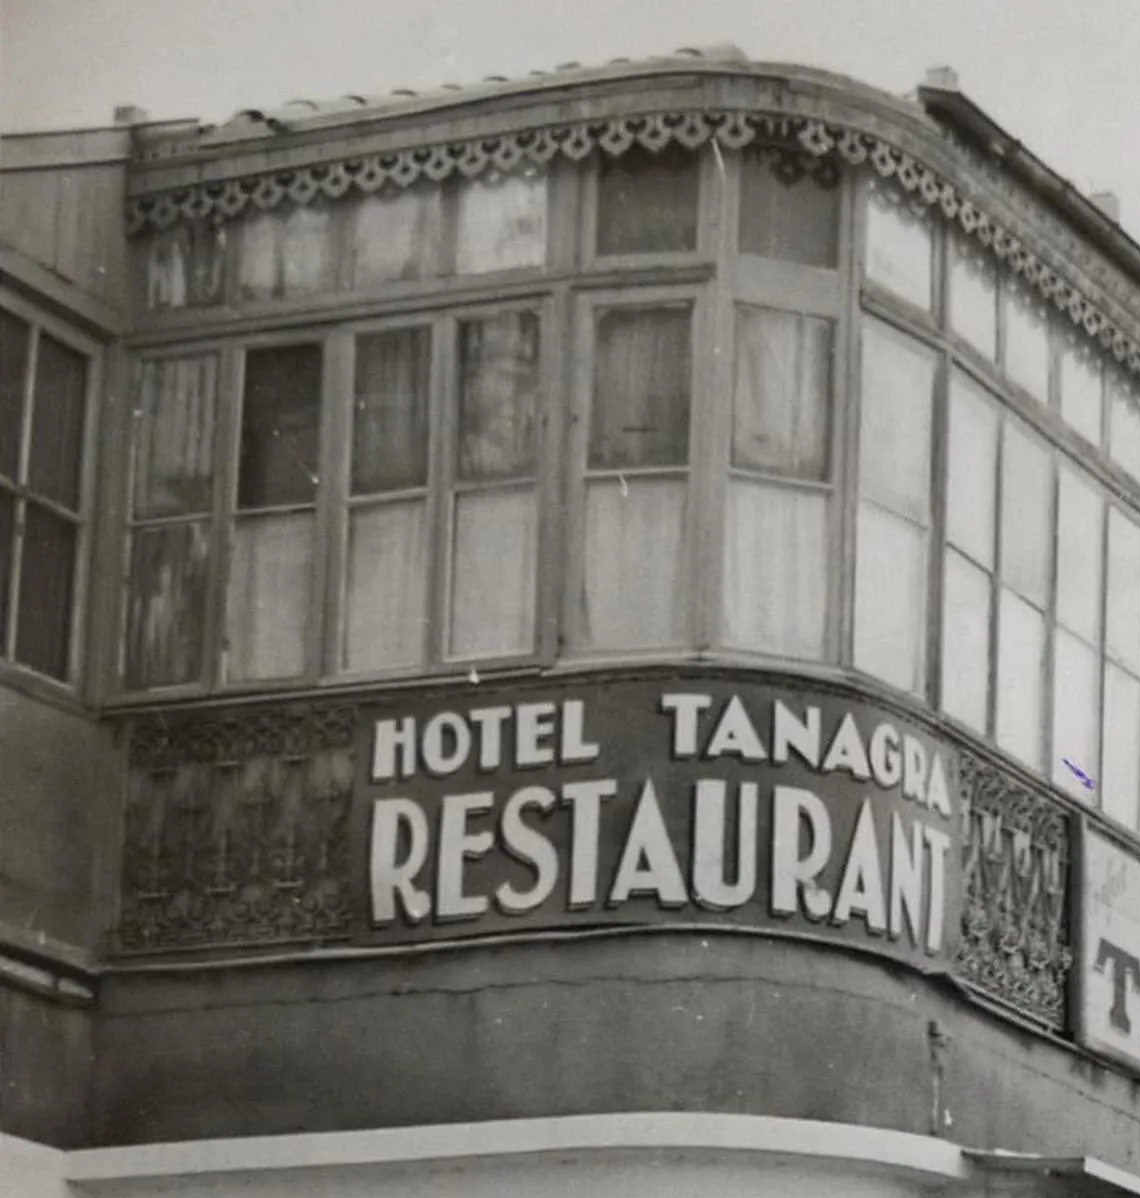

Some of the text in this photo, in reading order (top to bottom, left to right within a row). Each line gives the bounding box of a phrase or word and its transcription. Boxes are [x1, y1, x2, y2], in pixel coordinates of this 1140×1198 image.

[372, 693, 952, 816] HOTEL TANAGRA
[370, 778, 951, 954] RESTAURANT
